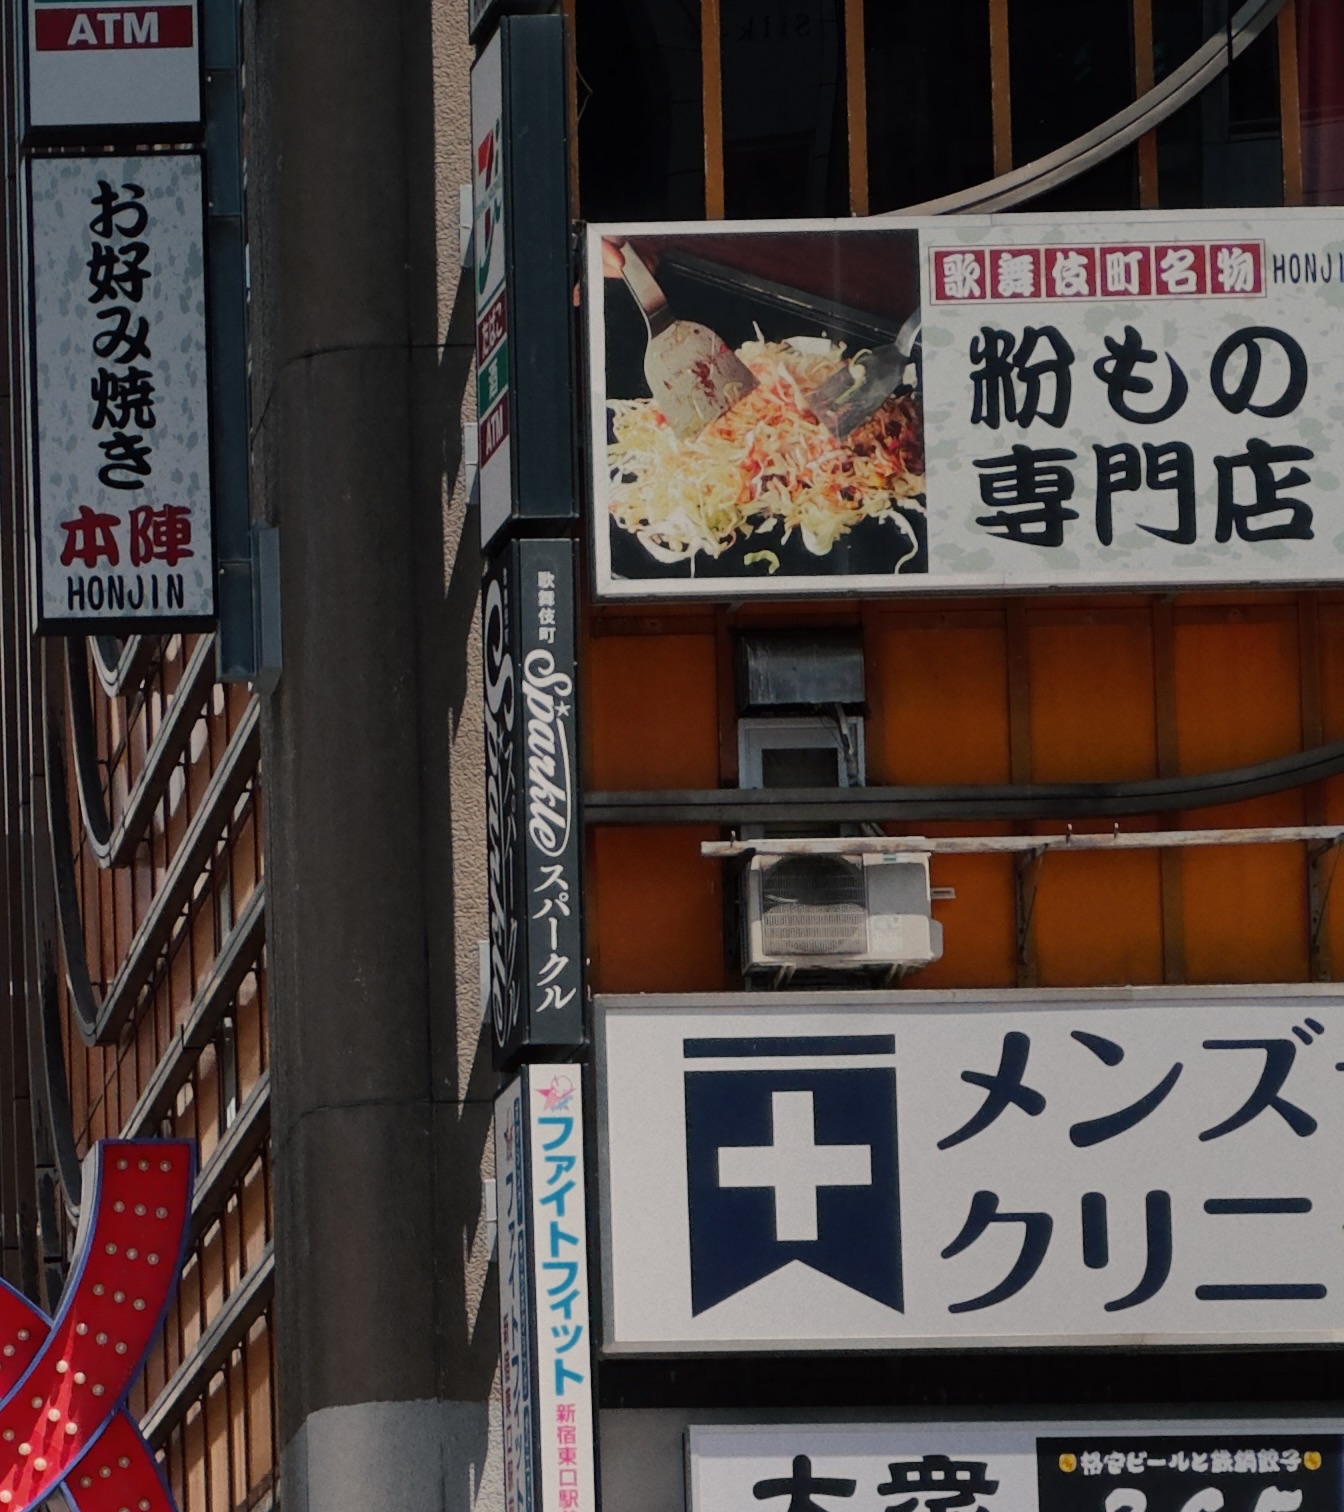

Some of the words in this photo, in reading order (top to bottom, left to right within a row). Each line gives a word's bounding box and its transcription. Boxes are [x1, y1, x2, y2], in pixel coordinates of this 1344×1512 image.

[66, 13, 160, 46] ATM
[942, 248, 1258, 299] 歌舞伎町名物
[87, 180, 156, 490] お好み焼き
[969, 325, 1309, 430] 粉もの
[60, 505, 194, 570] 本陣
[972, 438, 1315, 548] 専門店
[67, 574, 184, 612] HONJIN
[537, 570, 557, 645] 歌舞伎町
[522, 648, 573, 857] Sparkle
[532, 866, 576, 1013] スパークル
[538, 1116, 585, 1397] ファイトフィット
[941, 1190, 1327, 1314] クリニ
[1079, 1450, 1303, 1475] 格安ビールと鉄鍋餃子
